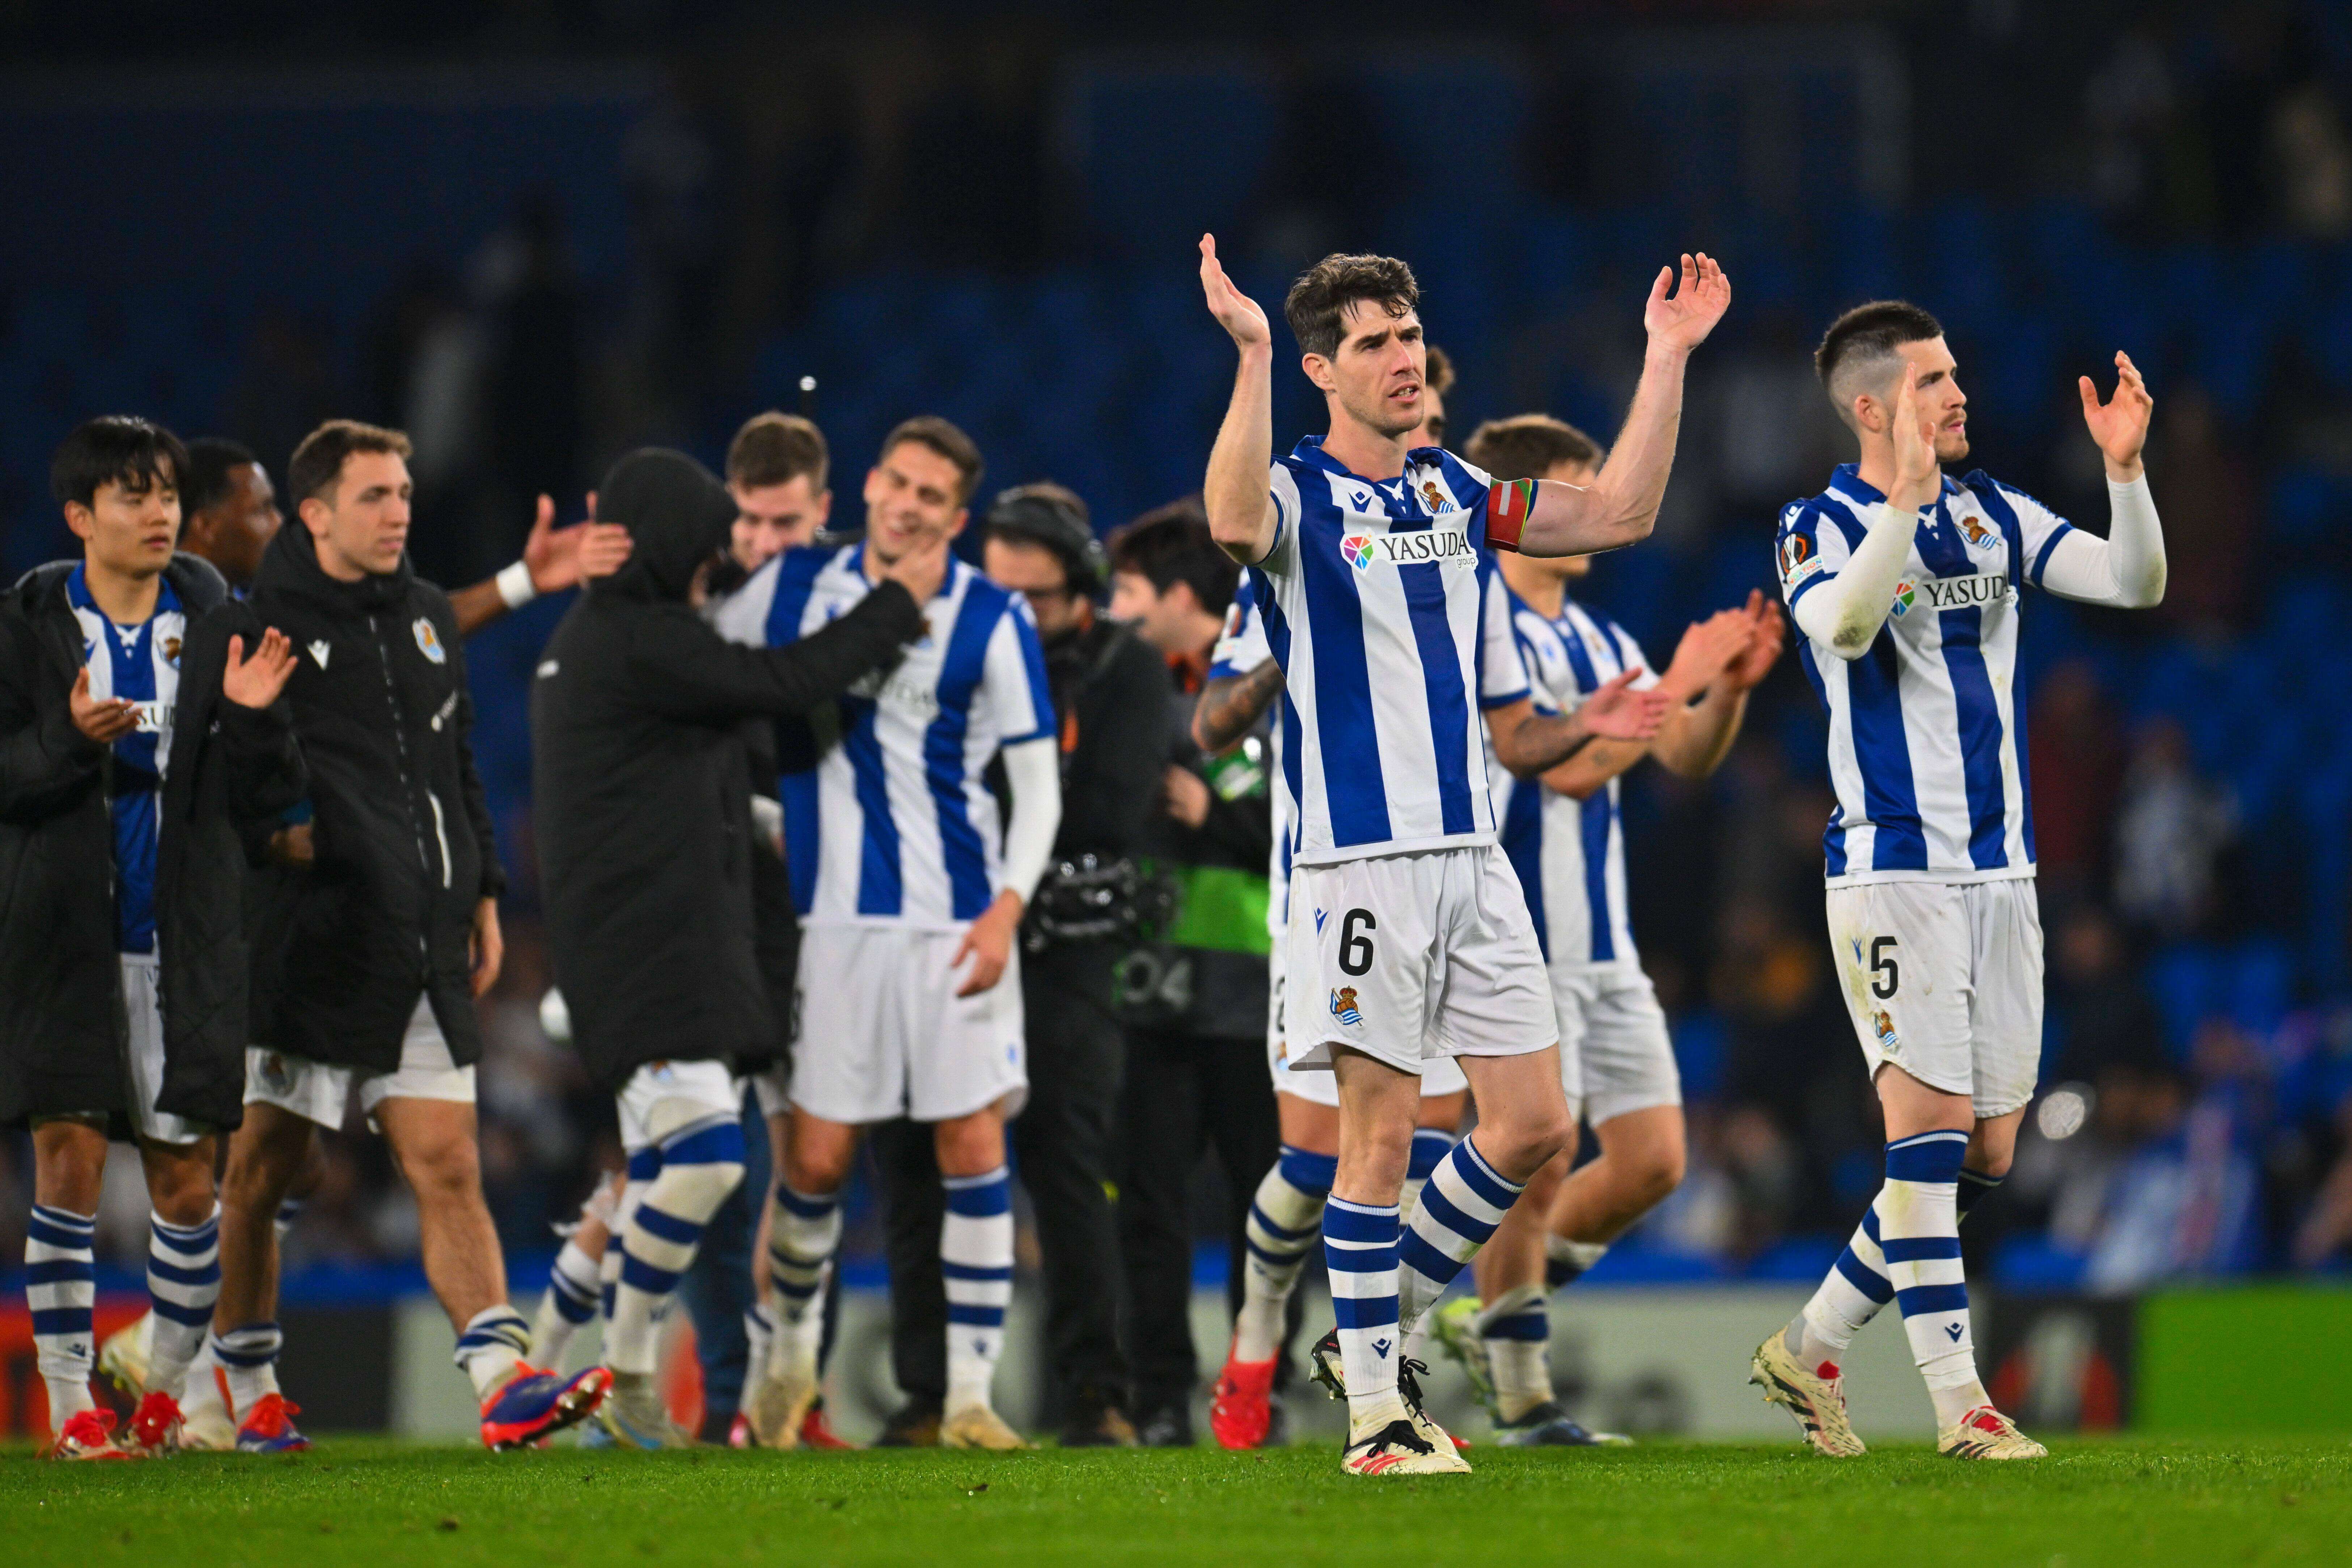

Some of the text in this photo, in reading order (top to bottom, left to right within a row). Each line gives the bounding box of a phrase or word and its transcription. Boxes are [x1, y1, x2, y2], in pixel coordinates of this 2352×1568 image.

[1379, 530, 1473, 561] YASUDA
[1456, 557, 1476, 568] group
[1338, 908, 1376, 976] 6
[1871, 936, 1898, 999] 5
